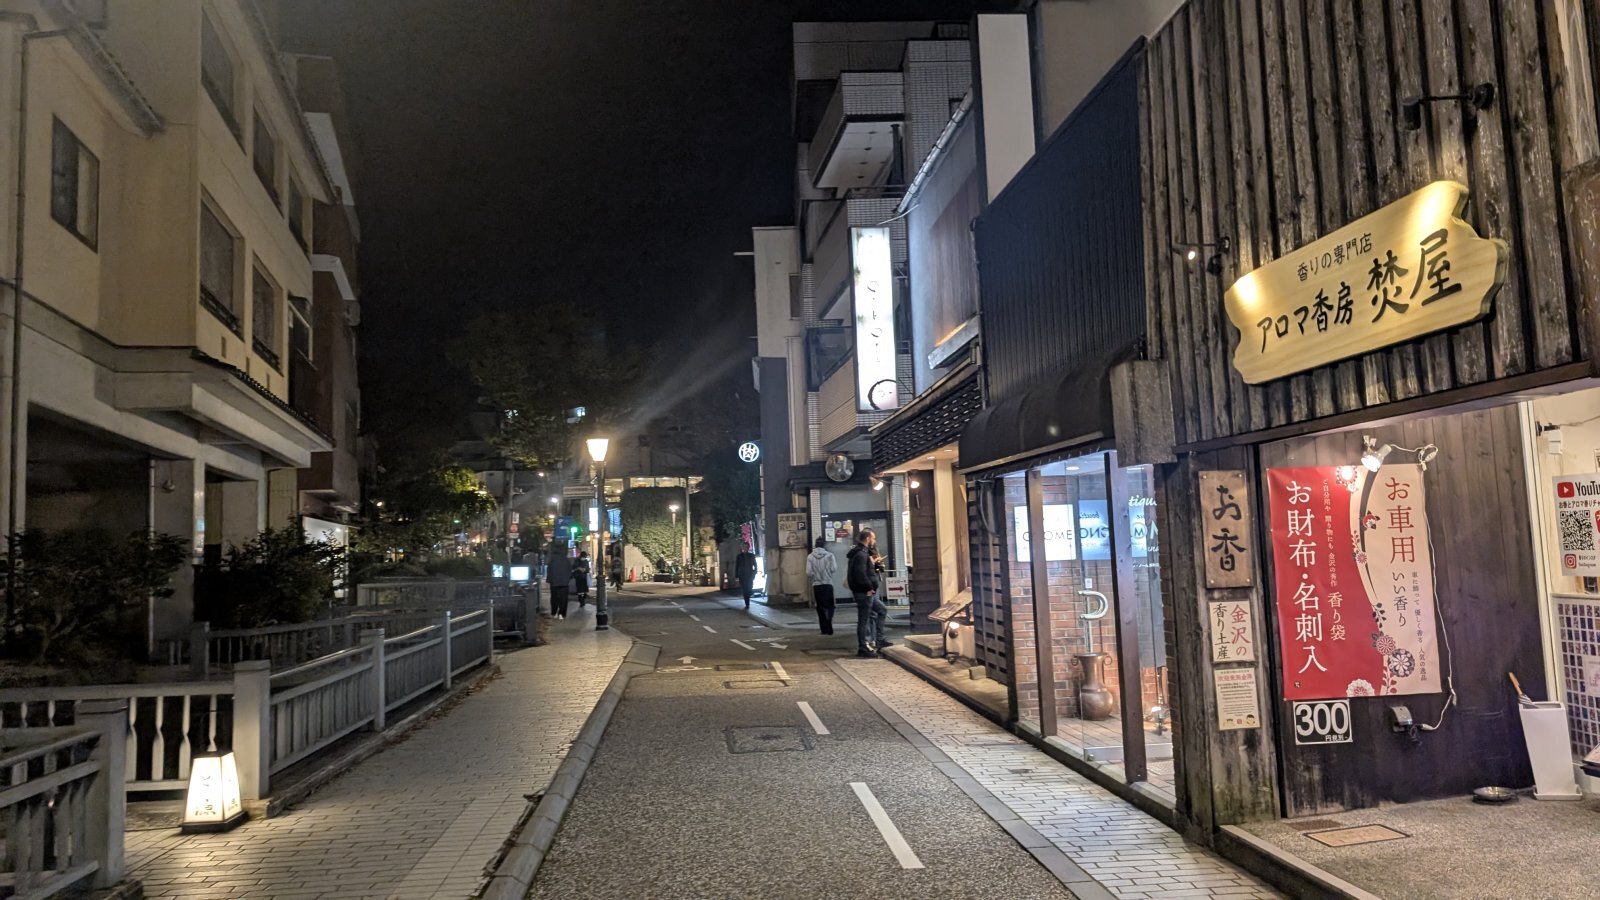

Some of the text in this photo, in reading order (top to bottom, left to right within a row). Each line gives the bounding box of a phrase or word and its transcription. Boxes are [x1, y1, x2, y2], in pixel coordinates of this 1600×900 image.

[1297, 232, 1372, 282] 香りの専門店
[1256, 228, 1462, 354] アロマ香房 焚屋
[798, 522, 805, 530] P
[1022, 529, 1073, 542] GOME
[1211, 485, 1247, 572] お香
[1384, 476, 1417, 565] お車用
[1286, 480, 1328, 674] お財布・名刺入
[1391, 571, 1409, 628] いい香り
[1212, 603, 1231, 660] 香り土産
[1230, 604, 1252, 656] 金沢の
[1327, 591, 1347, 641] 香り袋
[1296, 702, 1349, 737] 300
